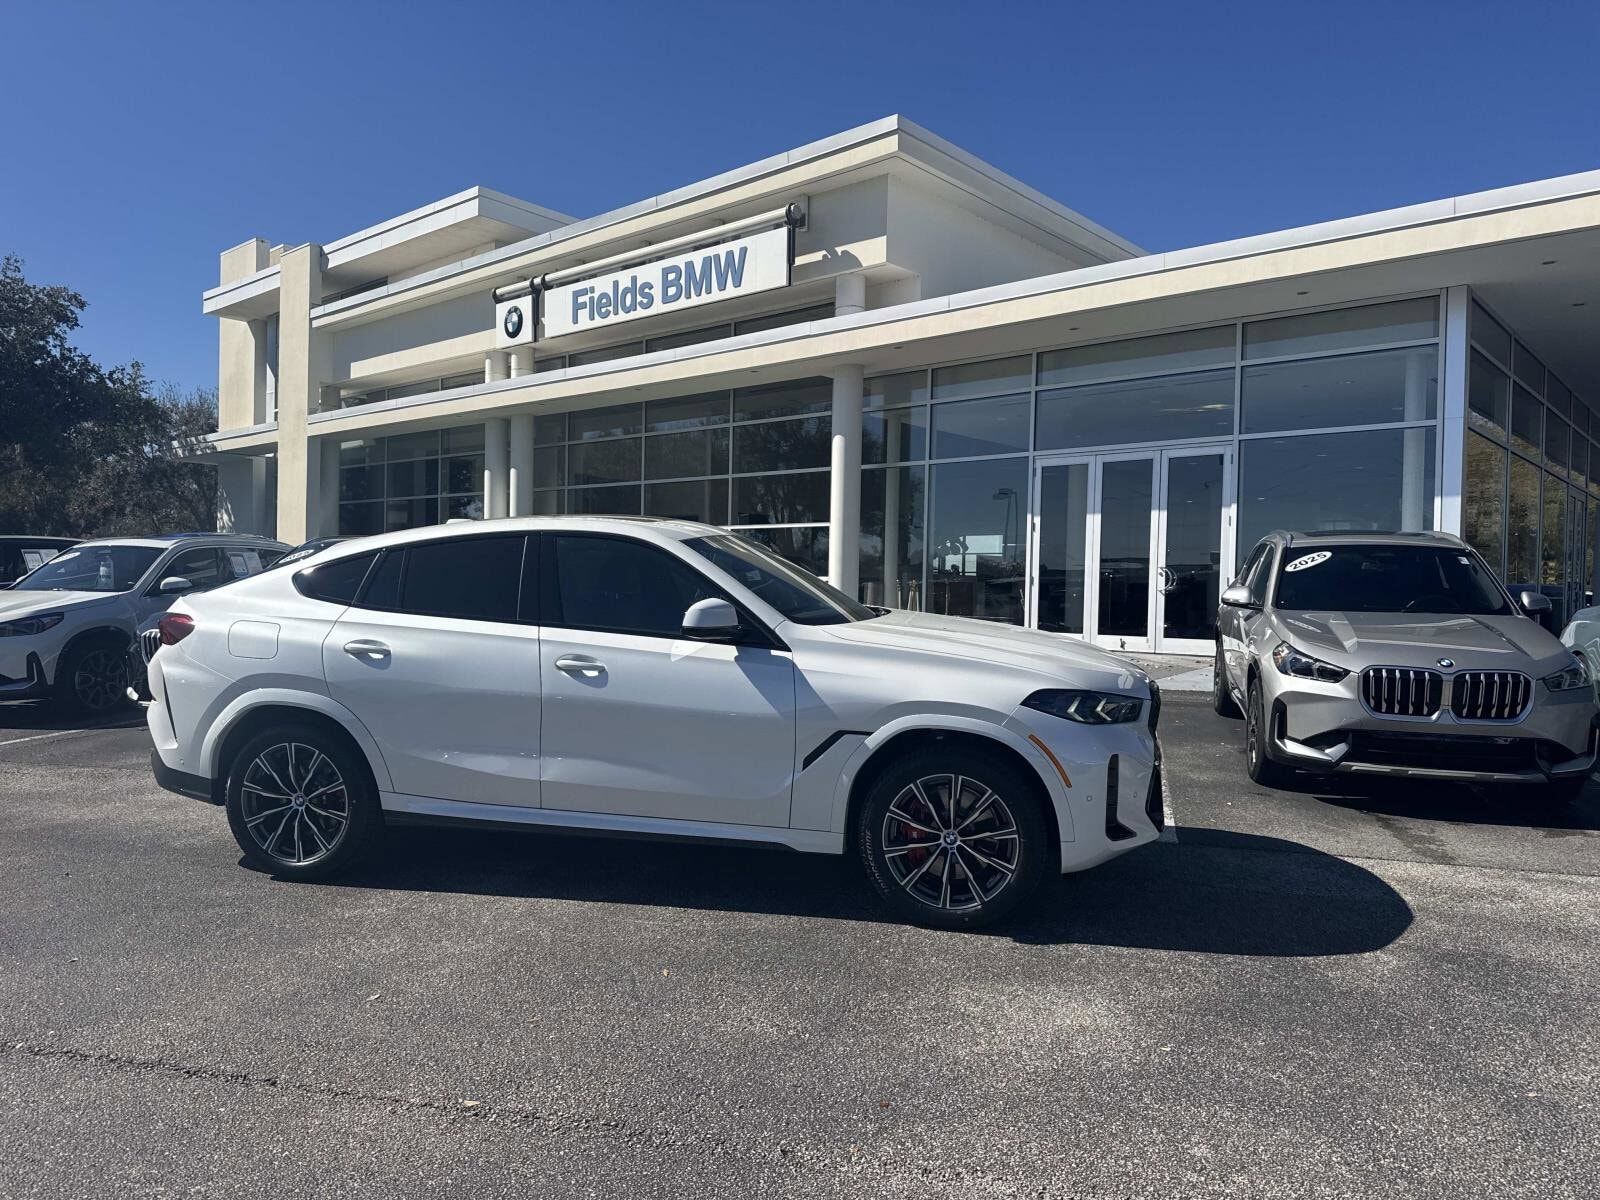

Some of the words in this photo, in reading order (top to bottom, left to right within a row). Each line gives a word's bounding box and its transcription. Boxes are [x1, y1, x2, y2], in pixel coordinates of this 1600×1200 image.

[572, 275, 654, 324] Fields
[661, 246, 748, 304] BMW
[1289, 552, 1327, 569] 2025
